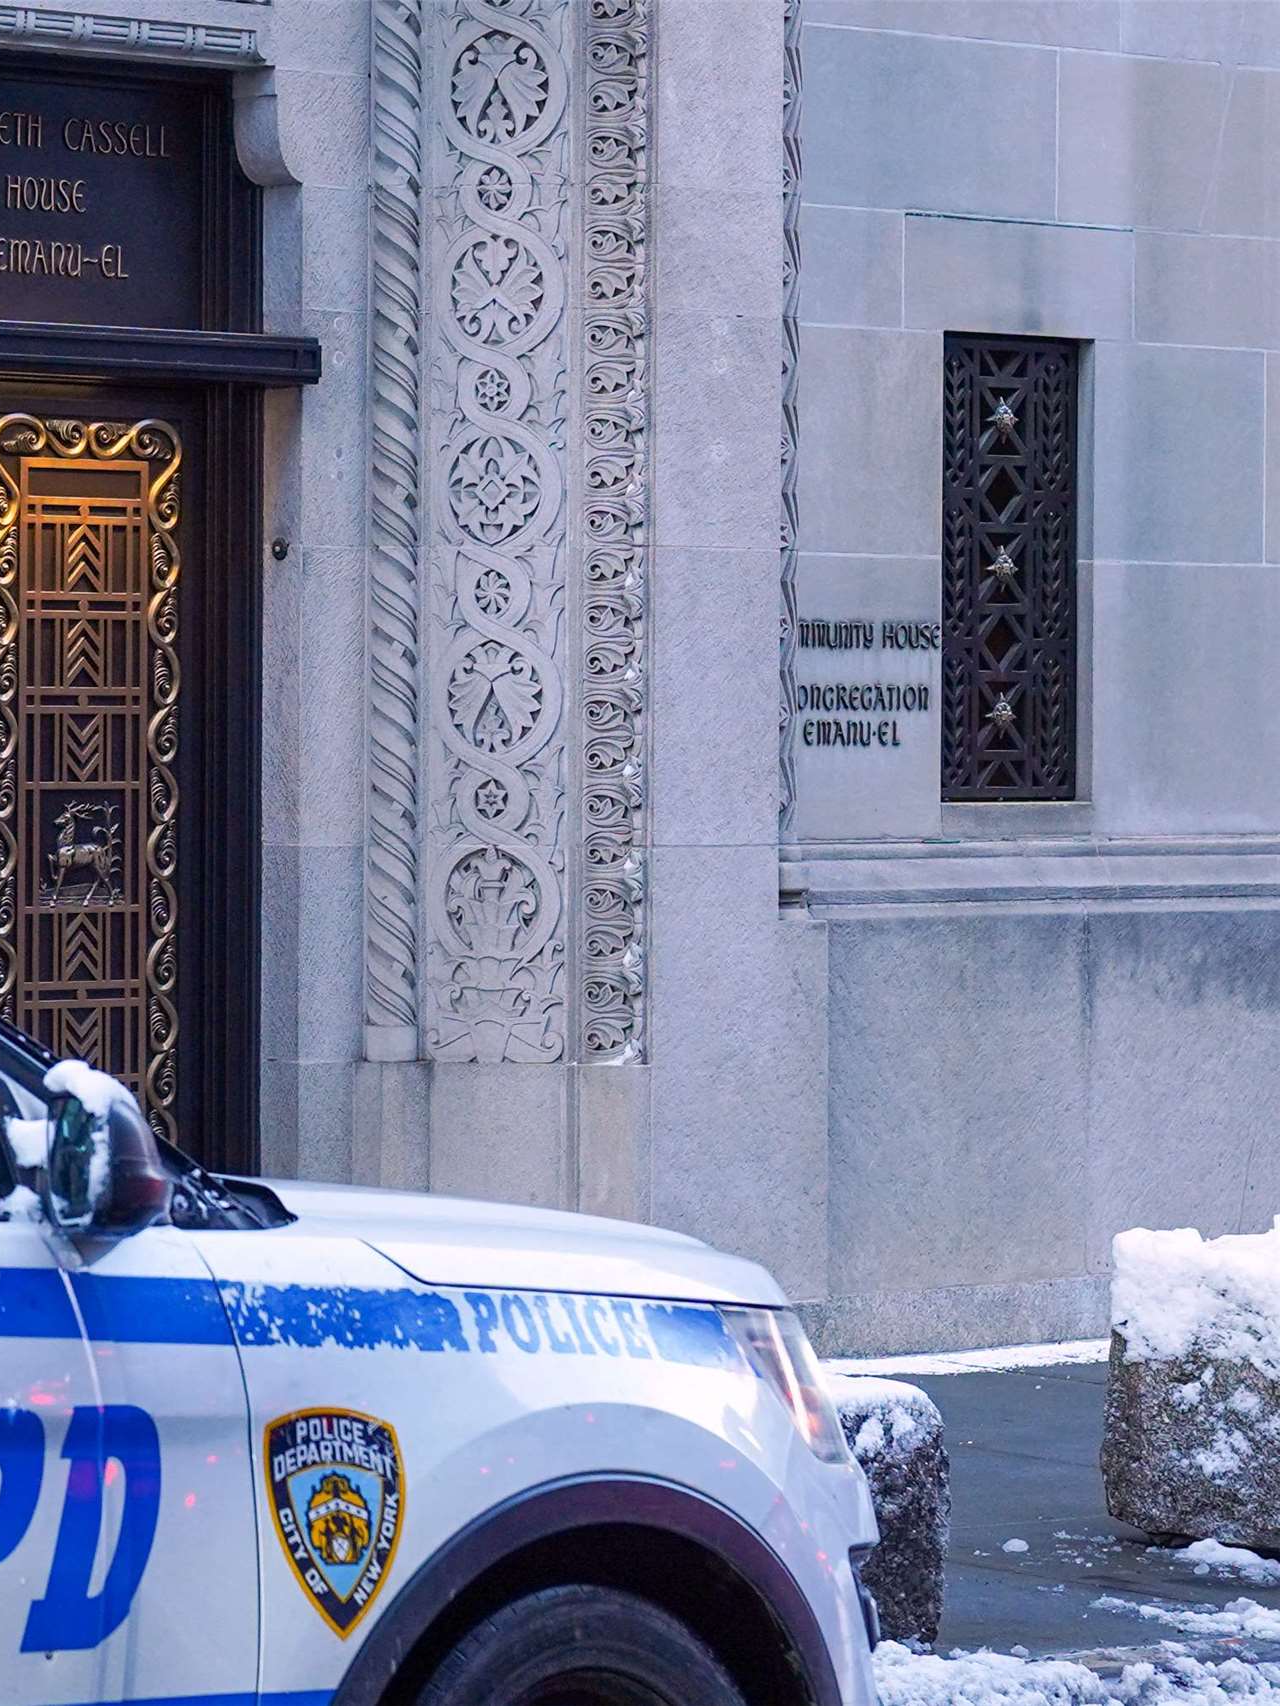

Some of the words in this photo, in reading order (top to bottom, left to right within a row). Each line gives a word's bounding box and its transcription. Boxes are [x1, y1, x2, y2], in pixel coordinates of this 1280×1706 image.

[64, 117, 171, 158] CASSELL
[6, 174, 87, 214] HOUSE
[798, 621, 874, 651] MMUNITY
[881, 621, 941, 651] HOUSE
[797, 683, 929, 713] ONGREGATION
[464, 1291, 654, 1360] POLICE
[296, 1417, 365, 1444] POLICE
[273, 1440, 397, 1483] DEPARTMENT
[278, 1507, 309, 1561] CITY
[305, 1569, 329, 1597] OF
[353, 1557, 384, 1607] NEW
[376, 1491, 400, 1551] YORK
